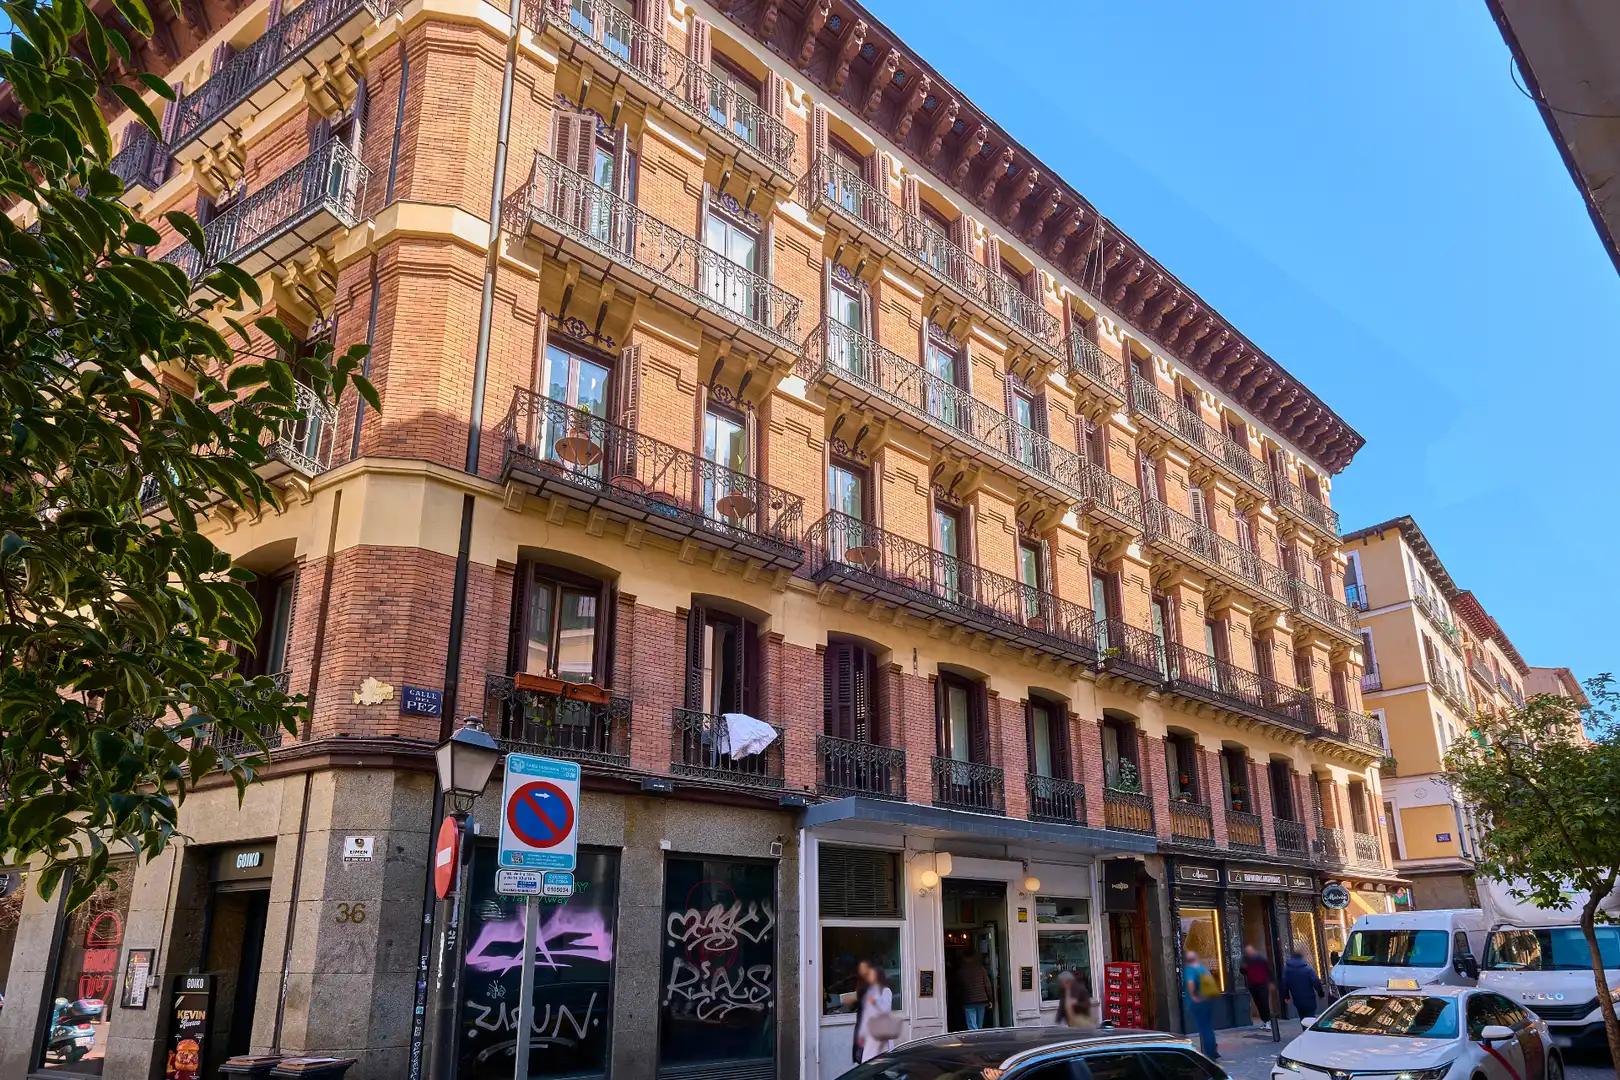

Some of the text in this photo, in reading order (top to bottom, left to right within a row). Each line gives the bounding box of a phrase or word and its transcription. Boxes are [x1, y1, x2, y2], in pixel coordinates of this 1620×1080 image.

[409, 689, 437, 700] CALLE
[406, 700, 437, 714] PEZ
[236, 851, 260, 869] GOIKO
[334, 902, 366, 924] 36
[186, 978, 204, 989] GOIKO
[177, 1009, 206, 1020] KEVIN
